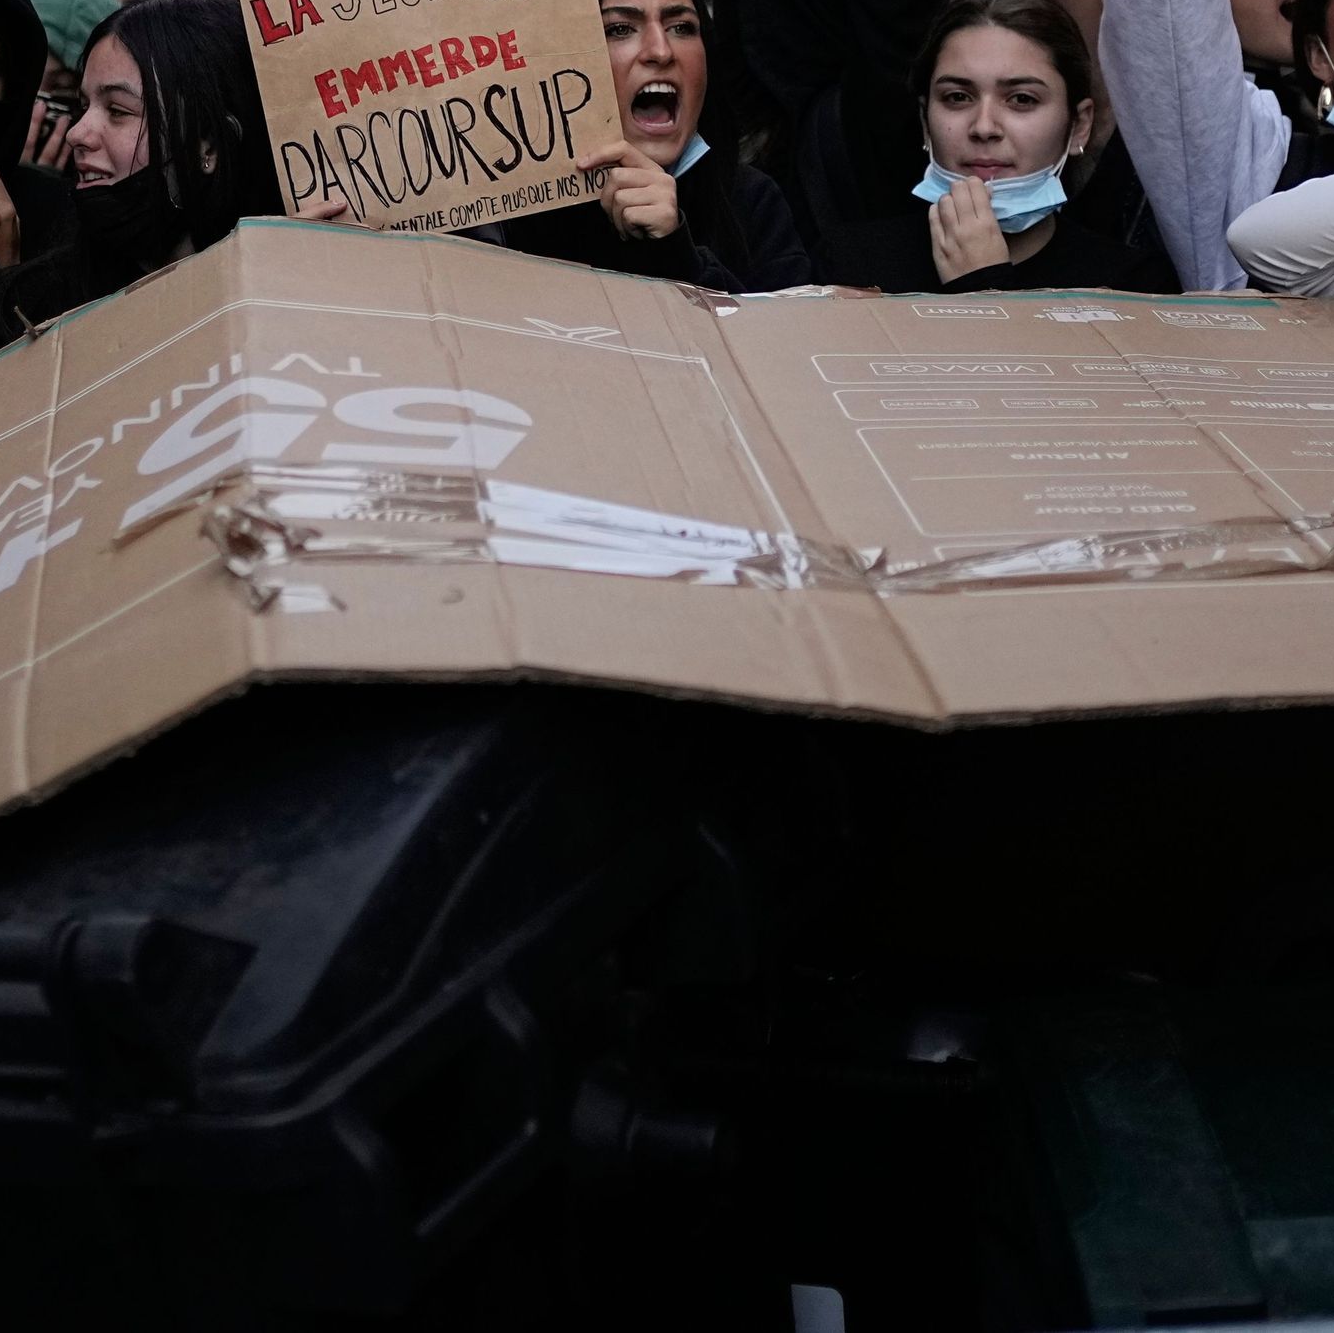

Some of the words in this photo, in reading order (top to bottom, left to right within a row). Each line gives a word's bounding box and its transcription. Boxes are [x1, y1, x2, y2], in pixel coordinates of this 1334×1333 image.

[314, 29, 527, 119] EMMERDE
[281, 68, 592, 223] PARCOURSUP
[449, 196, 499, 228] COMPTE
[502, 187, 528, 214] PLUS
[527, 181, 552, 205] QUE
[557, 174, 580, 200] NOS
[927, 307, 997, 316] FRONT
[269, 352, 382, 377] TV
[917, 441, 1050, 450] enhancement
[1010, 452, 1101, 461] Picture
[1107, 451, 1130, 459] AI
[1034, 505, 1124, 516] Colour
[1130, 503, 1198, 514] QLED
